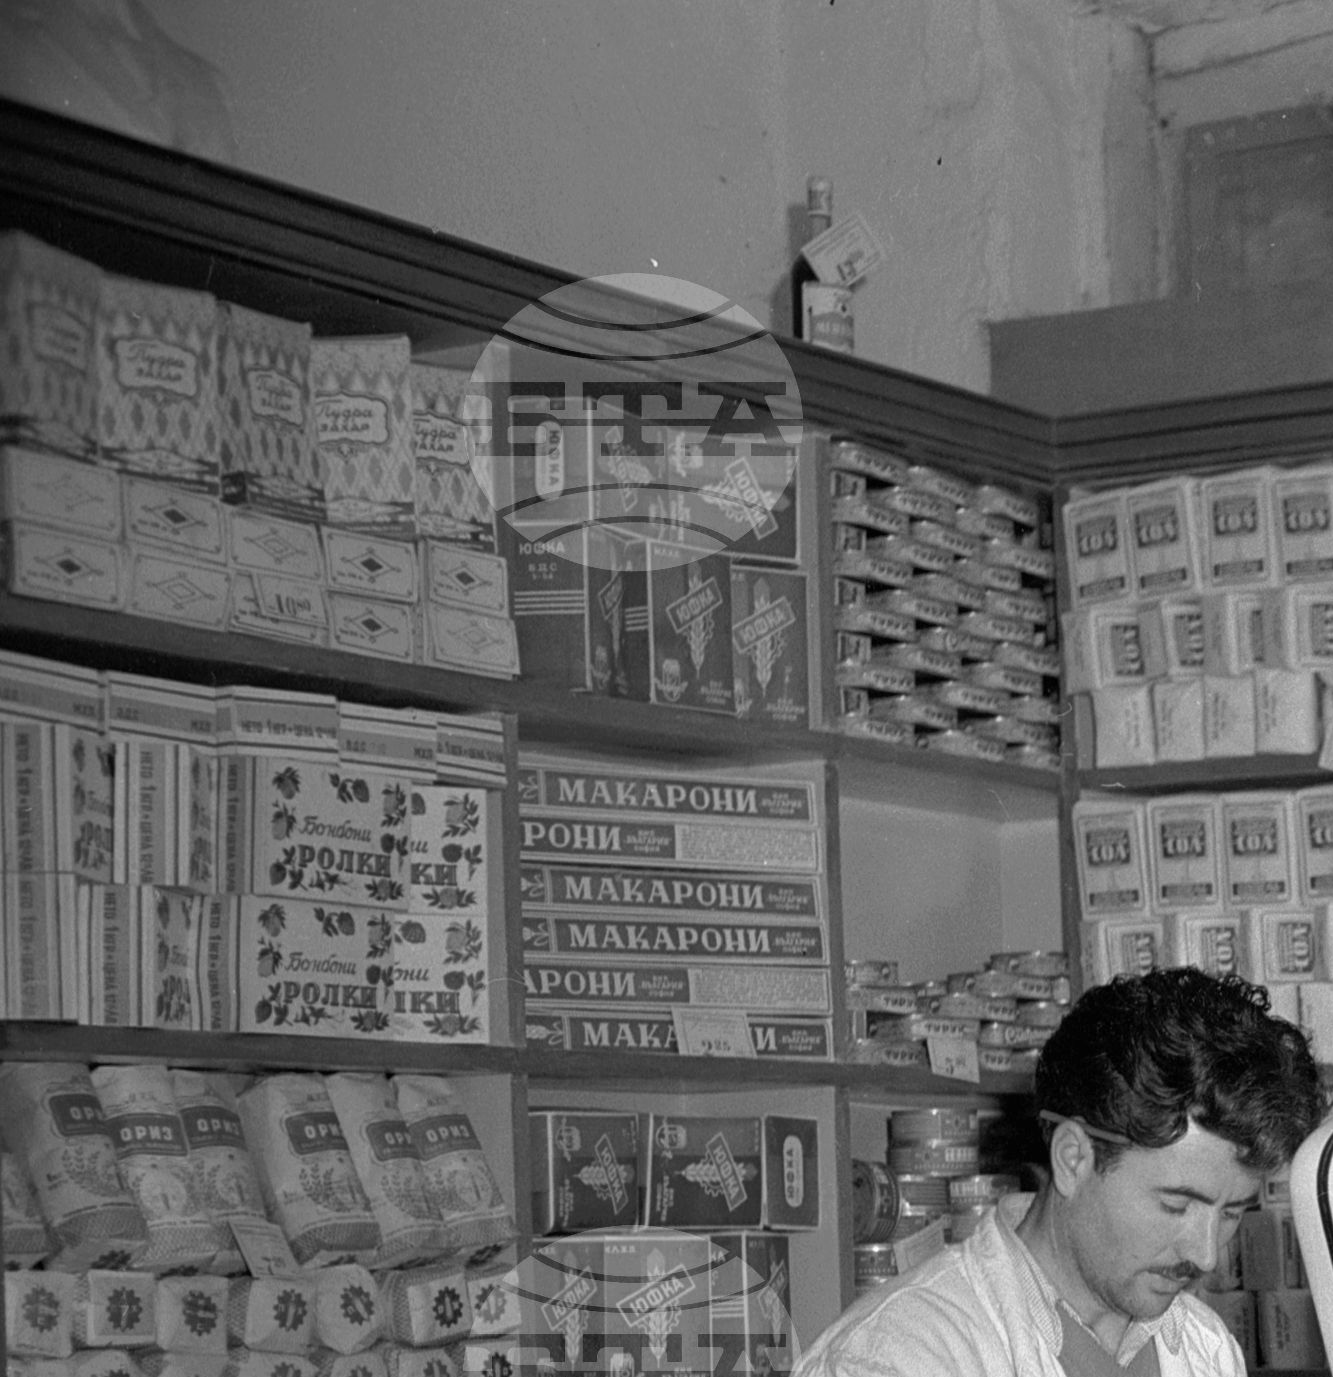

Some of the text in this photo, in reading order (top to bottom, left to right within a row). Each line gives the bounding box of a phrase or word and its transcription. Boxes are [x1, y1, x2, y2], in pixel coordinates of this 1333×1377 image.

[558, 777, 758, 814] МАКАРОНИ
[301, 815, 372, 842] Бонбони
[564, 875, 766, 910] МАКАРОНИ
[568, 923, 772, 953] МАКАРОНИ
[285, 951, 357, 976] Бонбони
[119, 1125, 174, 1142] ОРИЗ
[196, 1118, 241, 1136] ОРИЗ
[425, 1123, 471, 1142] ОРИЗ
[629, 1275, 685, 1317] ЮФКА
